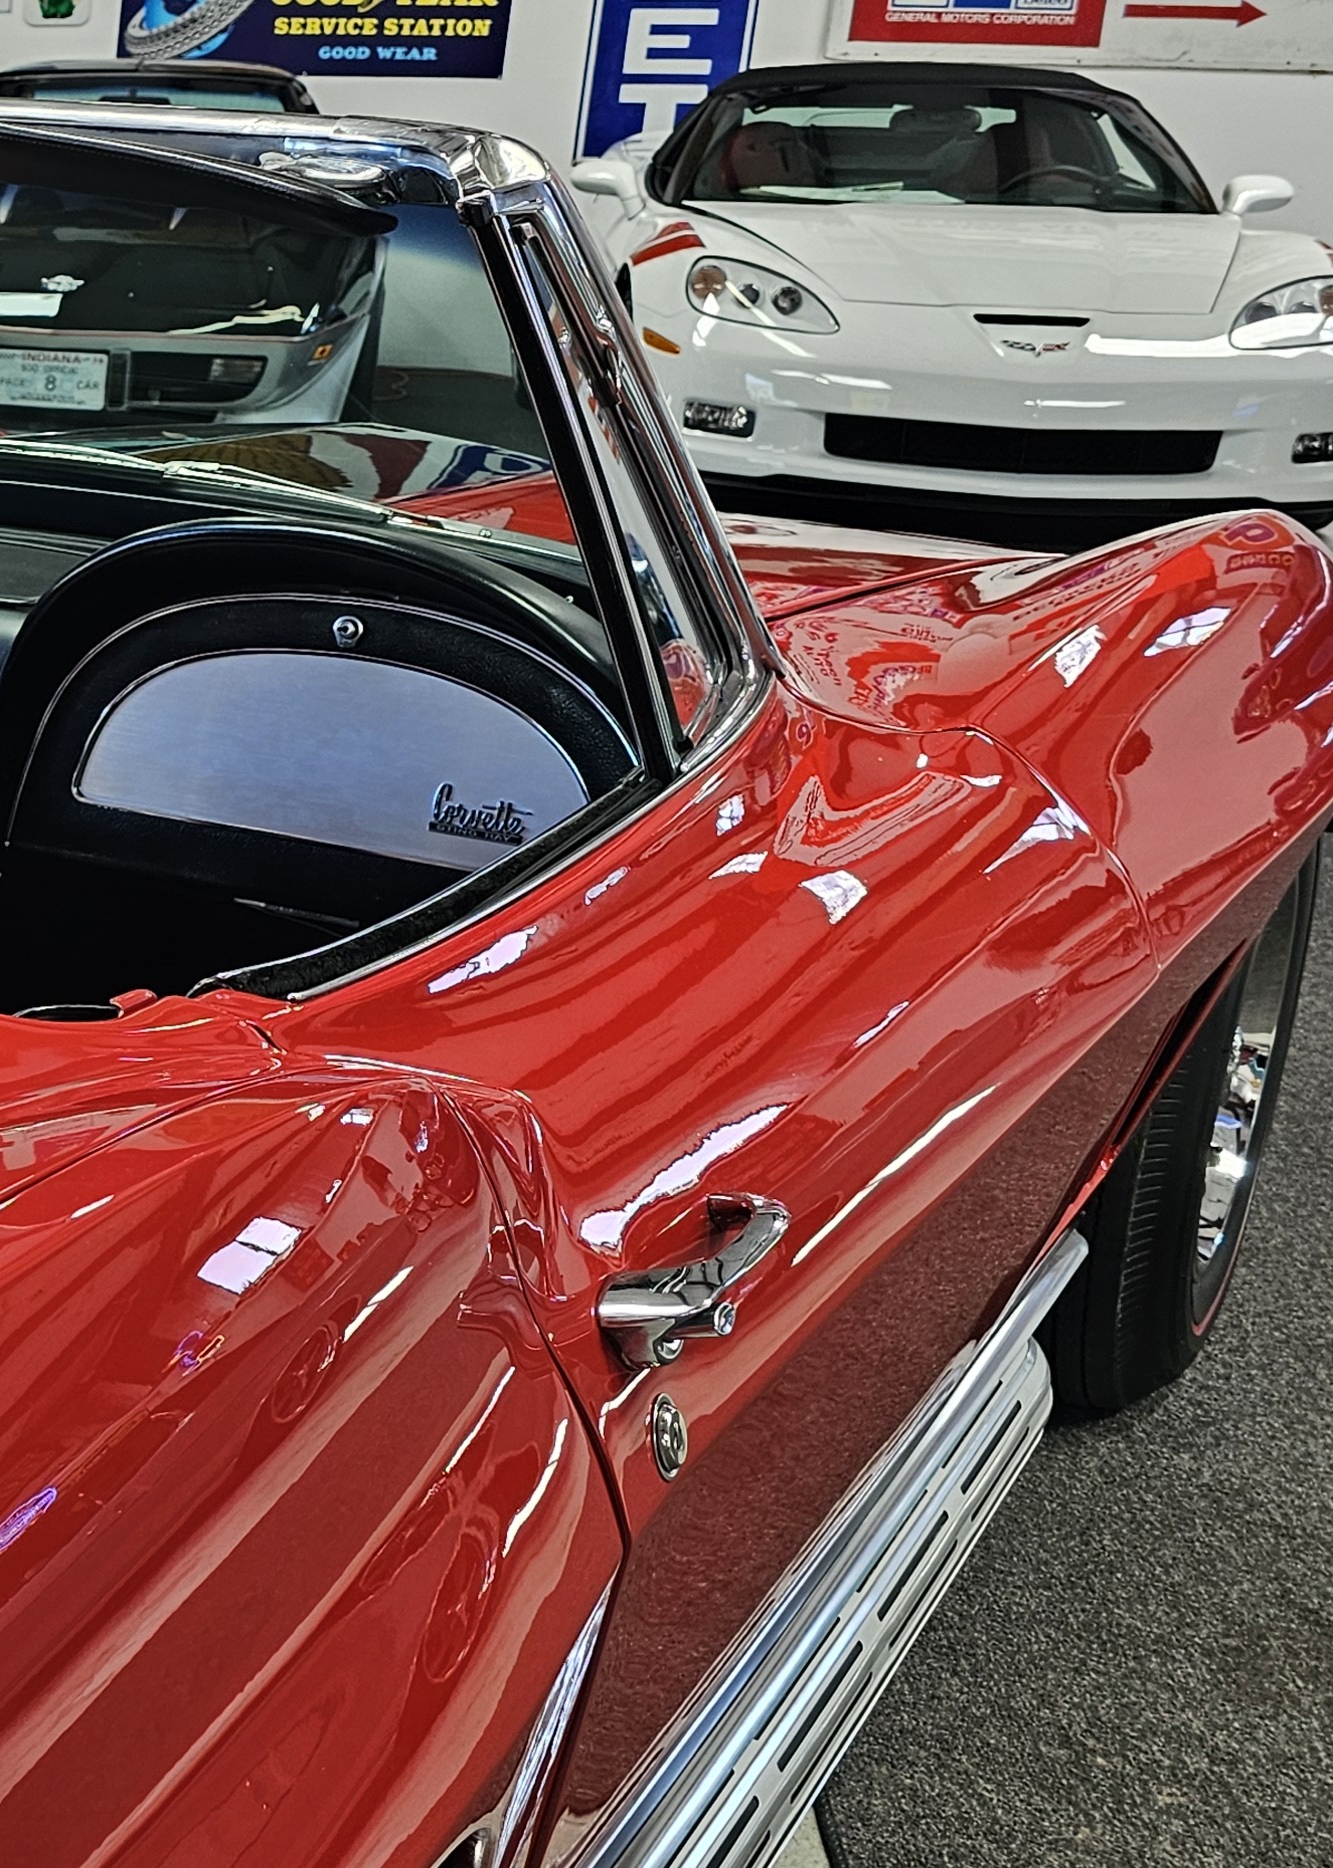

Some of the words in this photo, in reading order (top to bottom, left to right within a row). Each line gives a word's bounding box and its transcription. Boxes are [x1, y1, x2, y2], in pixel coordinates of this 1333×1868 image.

[274, 17, 379, 36] SERVICE
[383, 18, 493, 36] STATION
[885, 12, 938, 23] GENERAL
[941, 12, 991, 24] MOTORS
[992, 13, 1077, 25] CORPORATION
[318, 46, 371, 60] GOOD
[377, 46, 438, 61] WEAR
[23, 353, 81, 364] INDIANA
[45, 374, 57, 392] 8
[76, 380, 100, 390] CAR
[433, 782, 533, 836] Corvette
